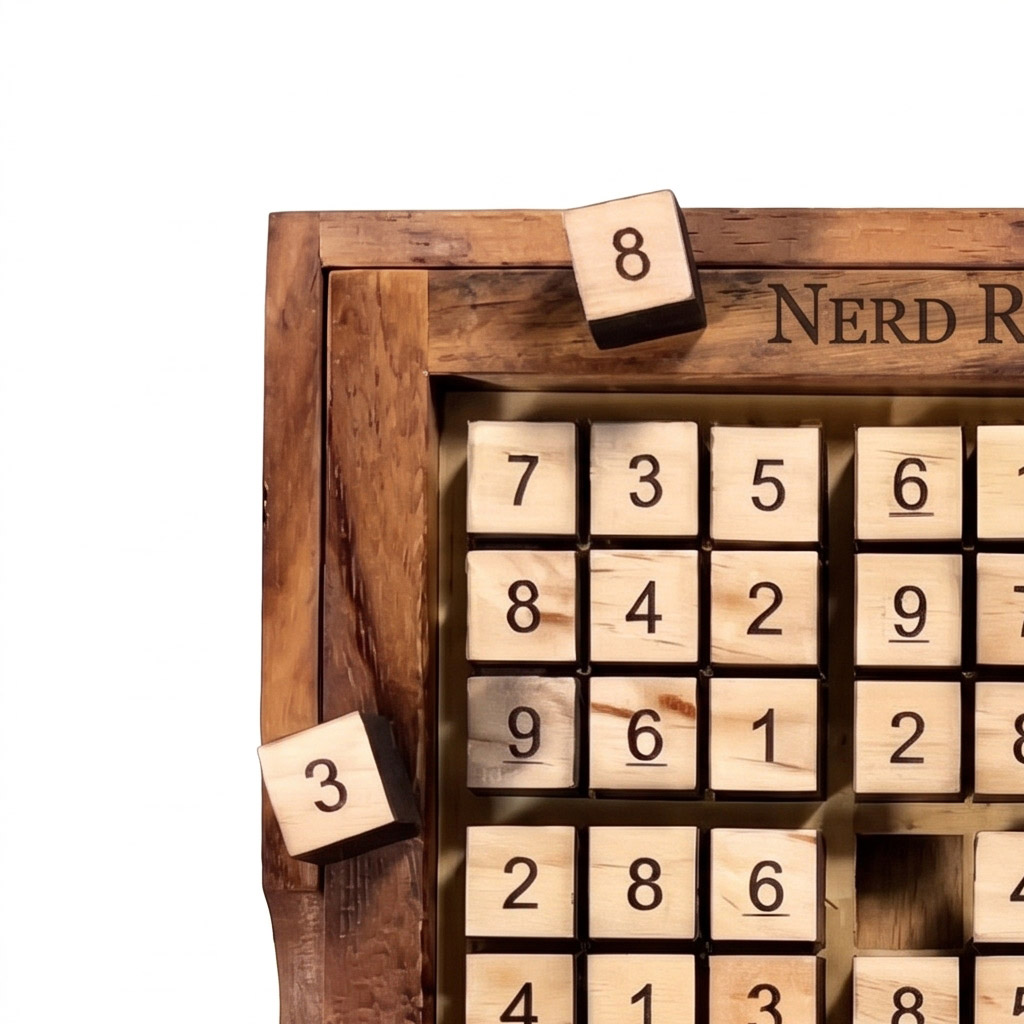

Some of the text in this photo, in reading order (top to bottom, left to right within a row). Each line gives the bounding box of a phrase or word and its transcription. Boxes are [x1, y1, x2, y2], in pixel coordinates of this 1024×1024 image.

[613, 227, 650, 281] 8
[767, 284, 957, 345] NERD
[508, 455, 538, 505] 7
[629, 454, 662, 507] 3
[752, 459, 785, 511] 5
[894, 458, 928, 510] 6
[507, 580, 541, 633] 8
[626, 581, 662, 633] 4
[747, 582, 783, 635] 2
[894, 586, 926, 637] 9
[508, 706, 540, 758] 9
[627, 709, 663, 761] 6
[753, 709, 774, 763] 1
[890, 712, 924, 763] 2
[305, 759, 347, 812] 3
[503, 857, 538, 909] 2
[628, 858, 662, 910] 8
[749, 861, 783, 912] 6
